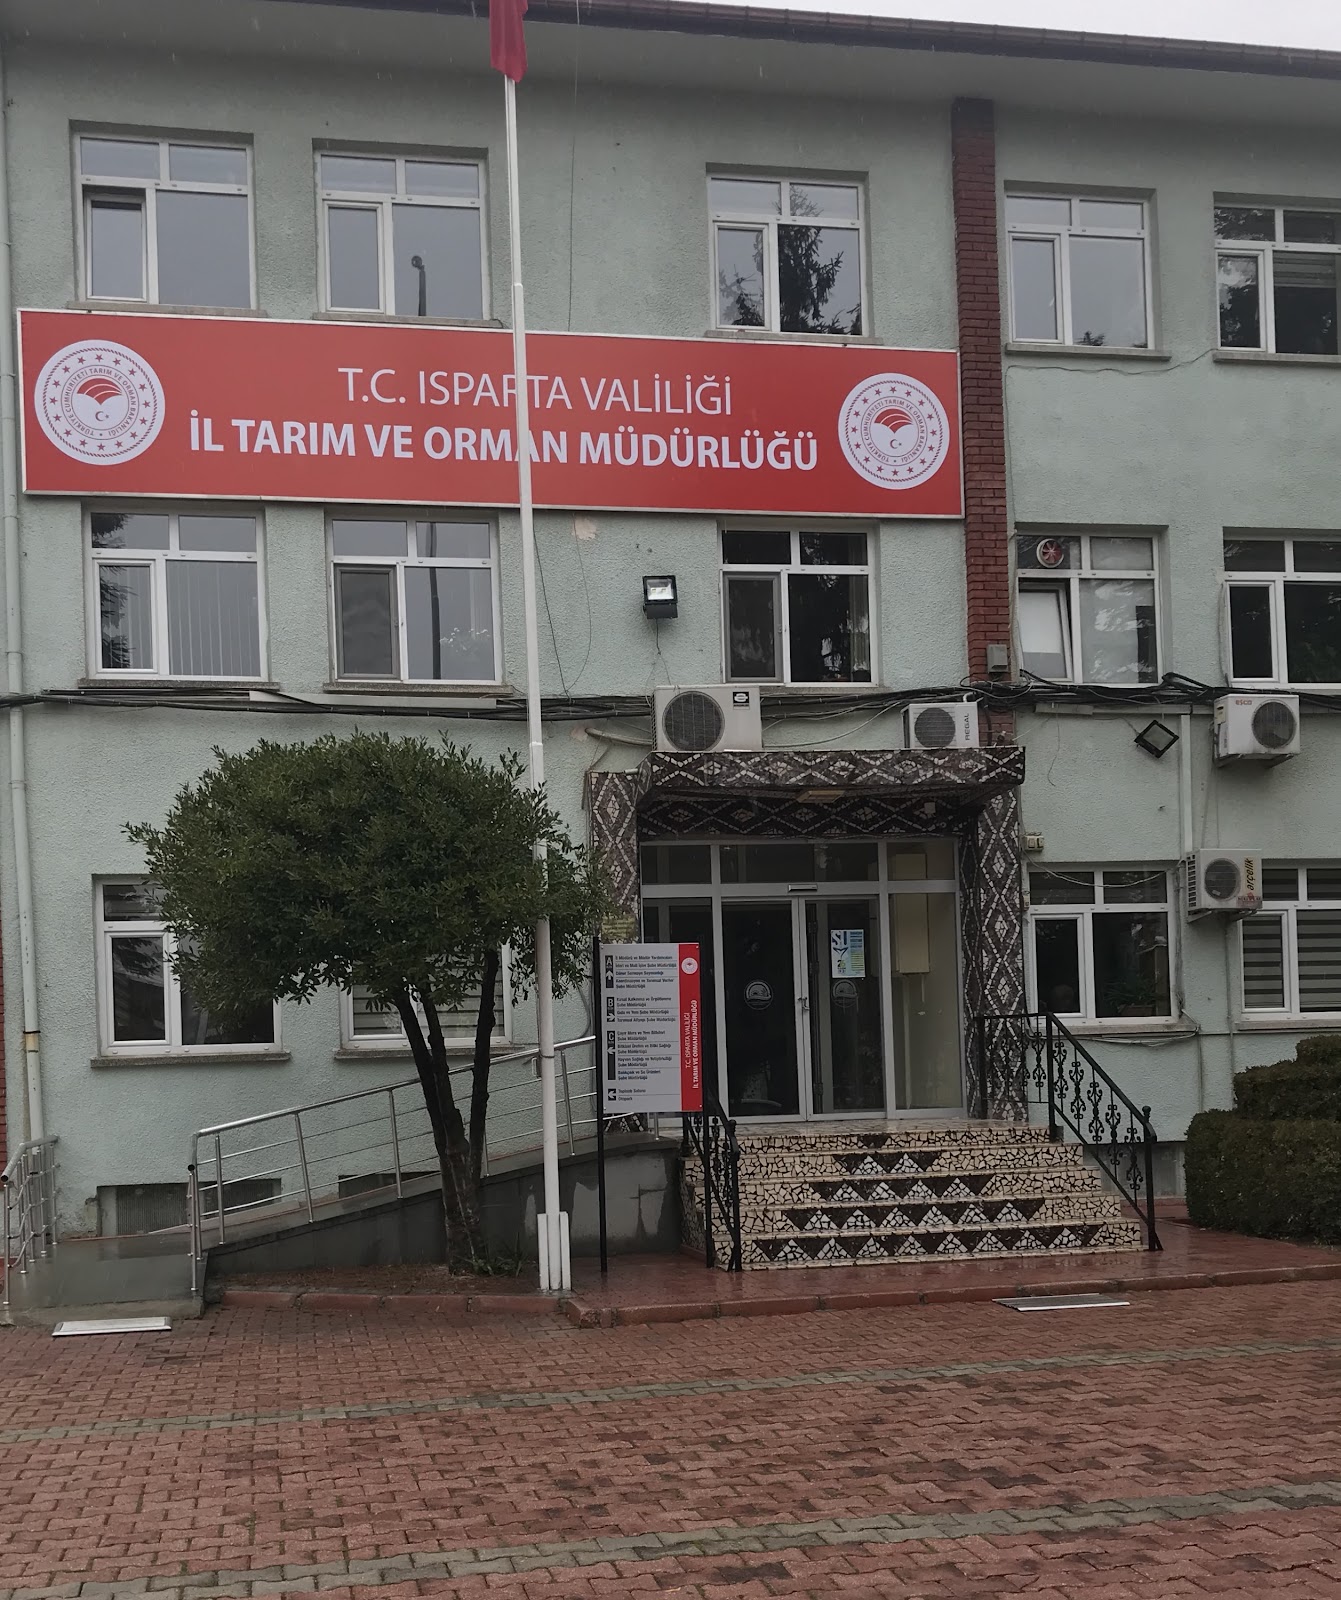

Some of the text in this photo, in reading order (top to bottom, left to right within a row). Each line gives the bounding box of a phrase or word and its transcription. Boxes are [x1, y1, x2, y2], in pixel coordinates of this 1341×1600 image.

[65, 367, 137, 437] TÜRKİYE CUMHURİYETİ TARIM VE ORMAN BAKANLIĞI
[338, 368, 731, 415] T.C. ISPARTA VALİLİĞİ
[190, 409, 225, 451] İL
[231, 418, 357, 457] TARIM
[363, 423, 414, 459] VE
[579, 426, 818, 471] MÜDÜRLÜĞÜ
[1244, 858, 1256, 892] arçelik
